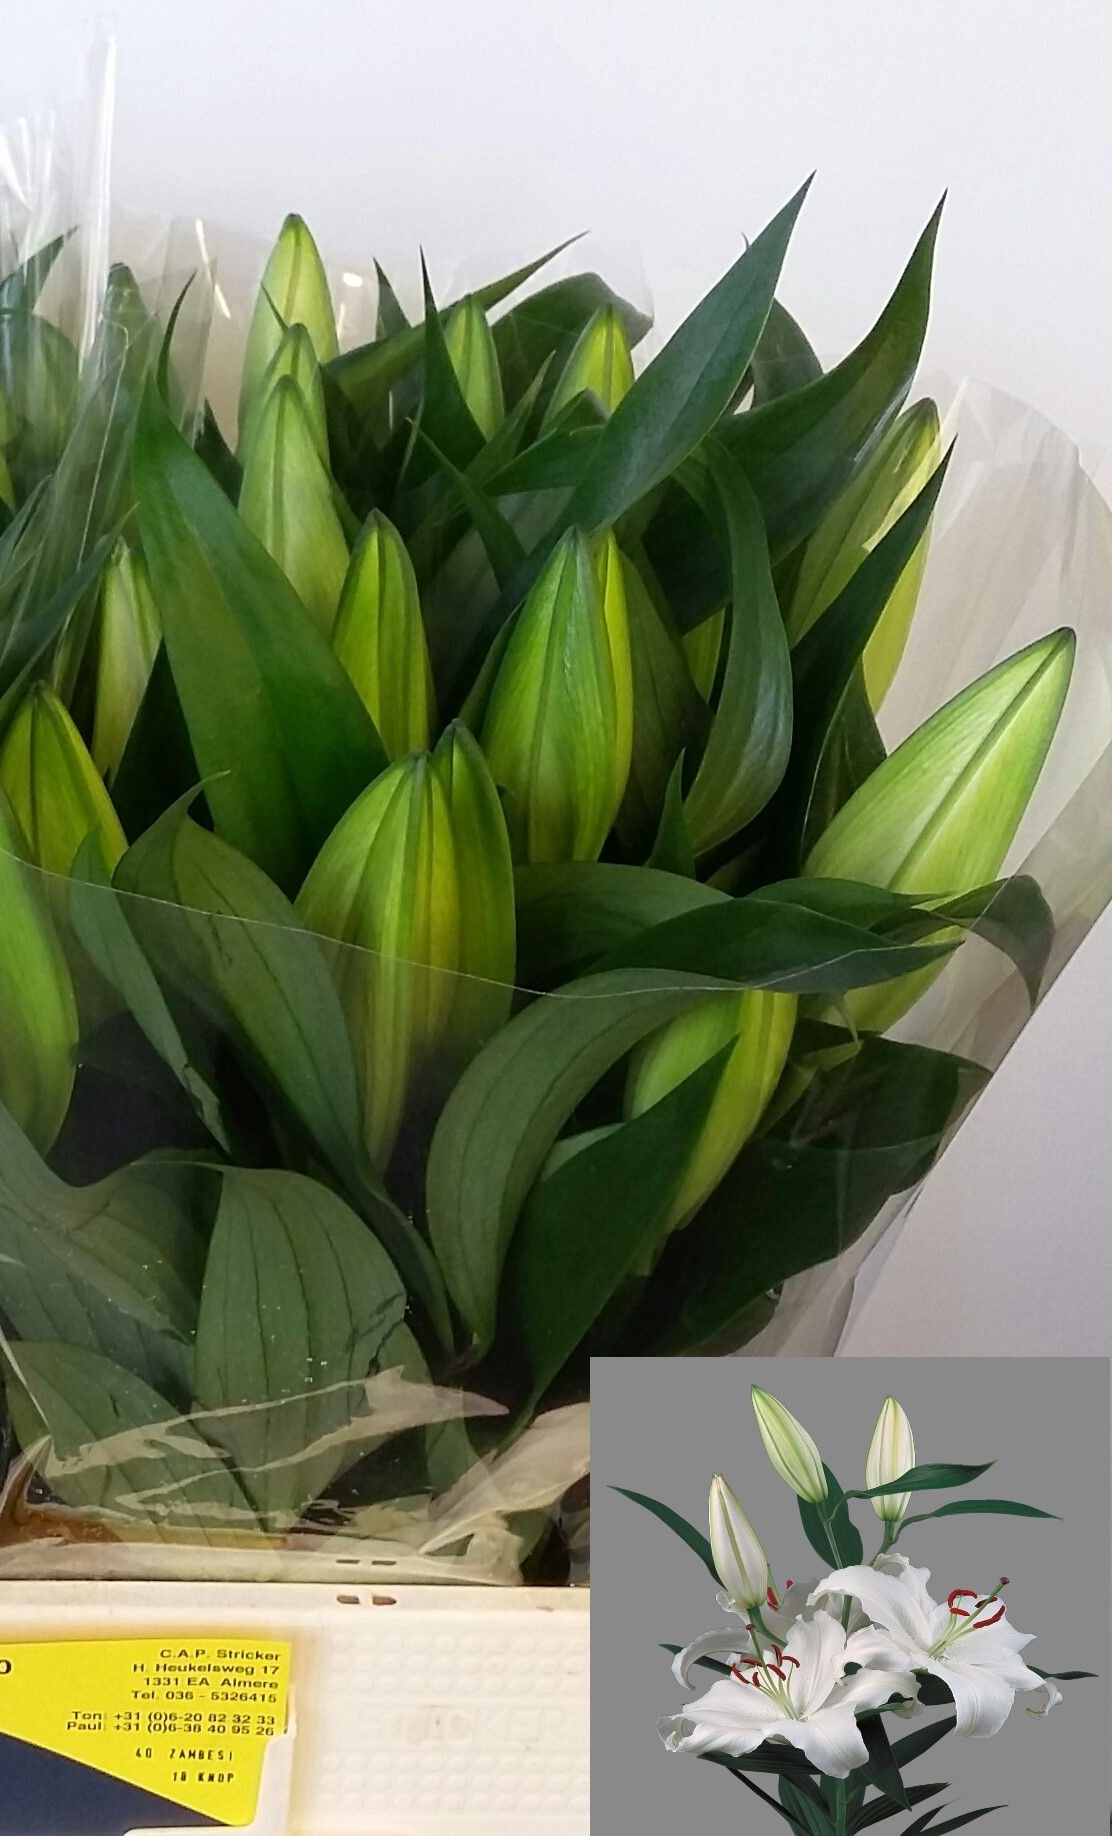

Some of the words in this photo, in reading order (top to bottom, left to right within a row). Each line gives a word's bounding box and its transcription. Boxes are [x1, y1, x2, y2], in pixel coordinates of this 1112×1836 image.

[217, 1649, 281, 1662] Stricker
[155, 1663, 255, 1676] Heukelsweg
[262, 1664, 280, 1675] 17
[144, 1676, 179, 1687] 1331
[187, 1676, 211, 1687] EA
[220, 1677, 279, 1690] Almere
[165, 1690, 194, 1701] 036
[210, 1690, 277, 1704] 5326415
[114, 1712, 141, 1721] +31
[147, 1711, 202, 1723] (0)6-20
[232, 1713, 252, 1724] 32
[256, 1715, 276, 1725] 33
[113, 1722, 140, 1732] +31
[147, 1722, 202, 1734] (0)6-38
[207, 1724, 228, 1734] 40
[232, 1724, 251, 1735] 95
[255, 1726, 274, 1736] 26
[135, 1747, 152, 1759] 40
[169, 1748, 232, 1761] ZAMBESI
[198, 1772, 234, 1783] KNOP
